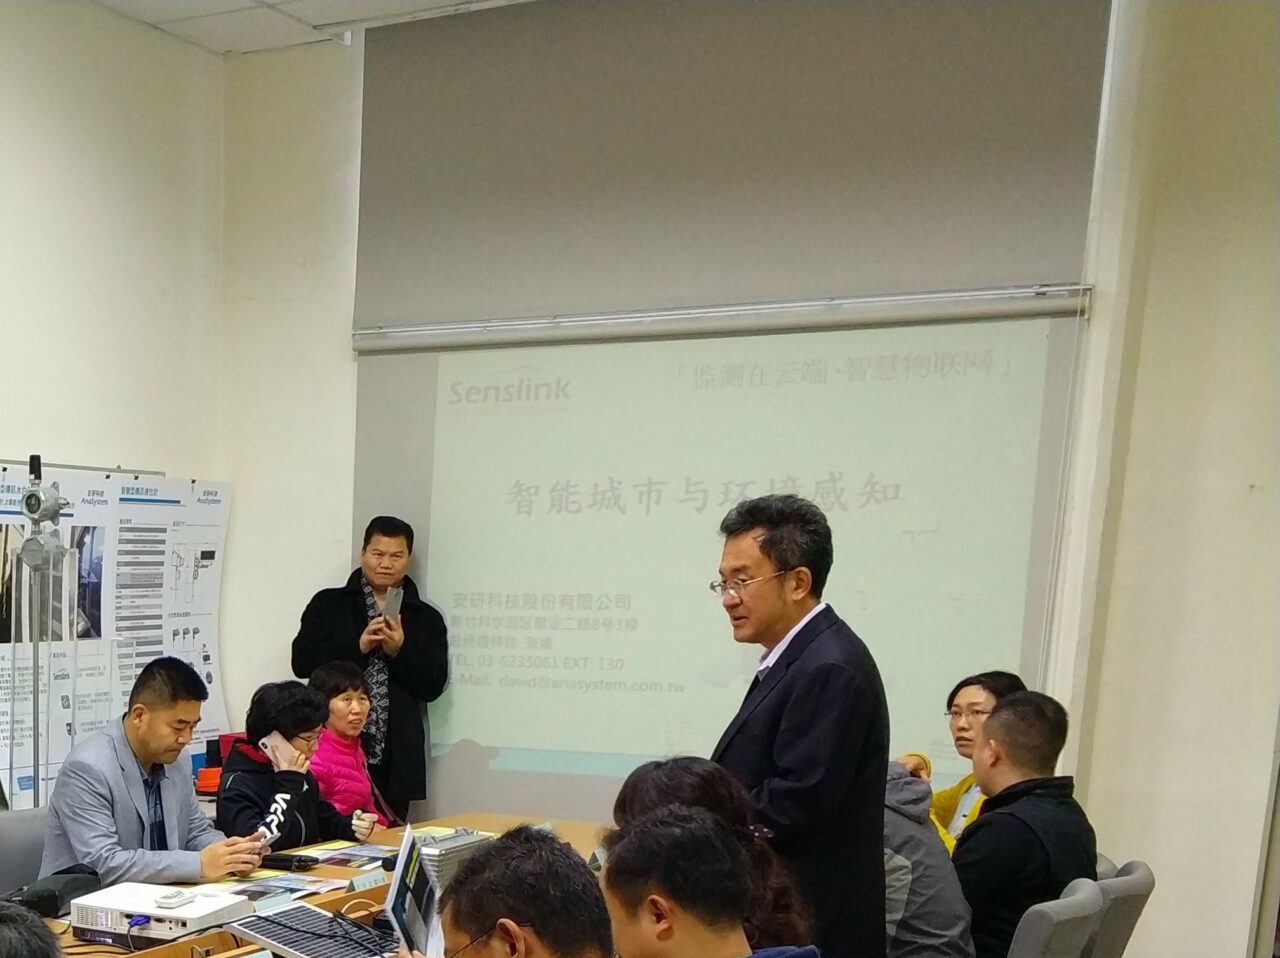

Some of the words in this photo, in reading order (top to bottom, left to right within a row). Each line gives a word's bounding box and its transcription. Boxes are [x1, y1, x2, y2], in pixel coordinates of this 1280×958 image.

[448, 376, 571, 404] Senslink
[452, 592, 632, 611] 安研科技股份有限公司
